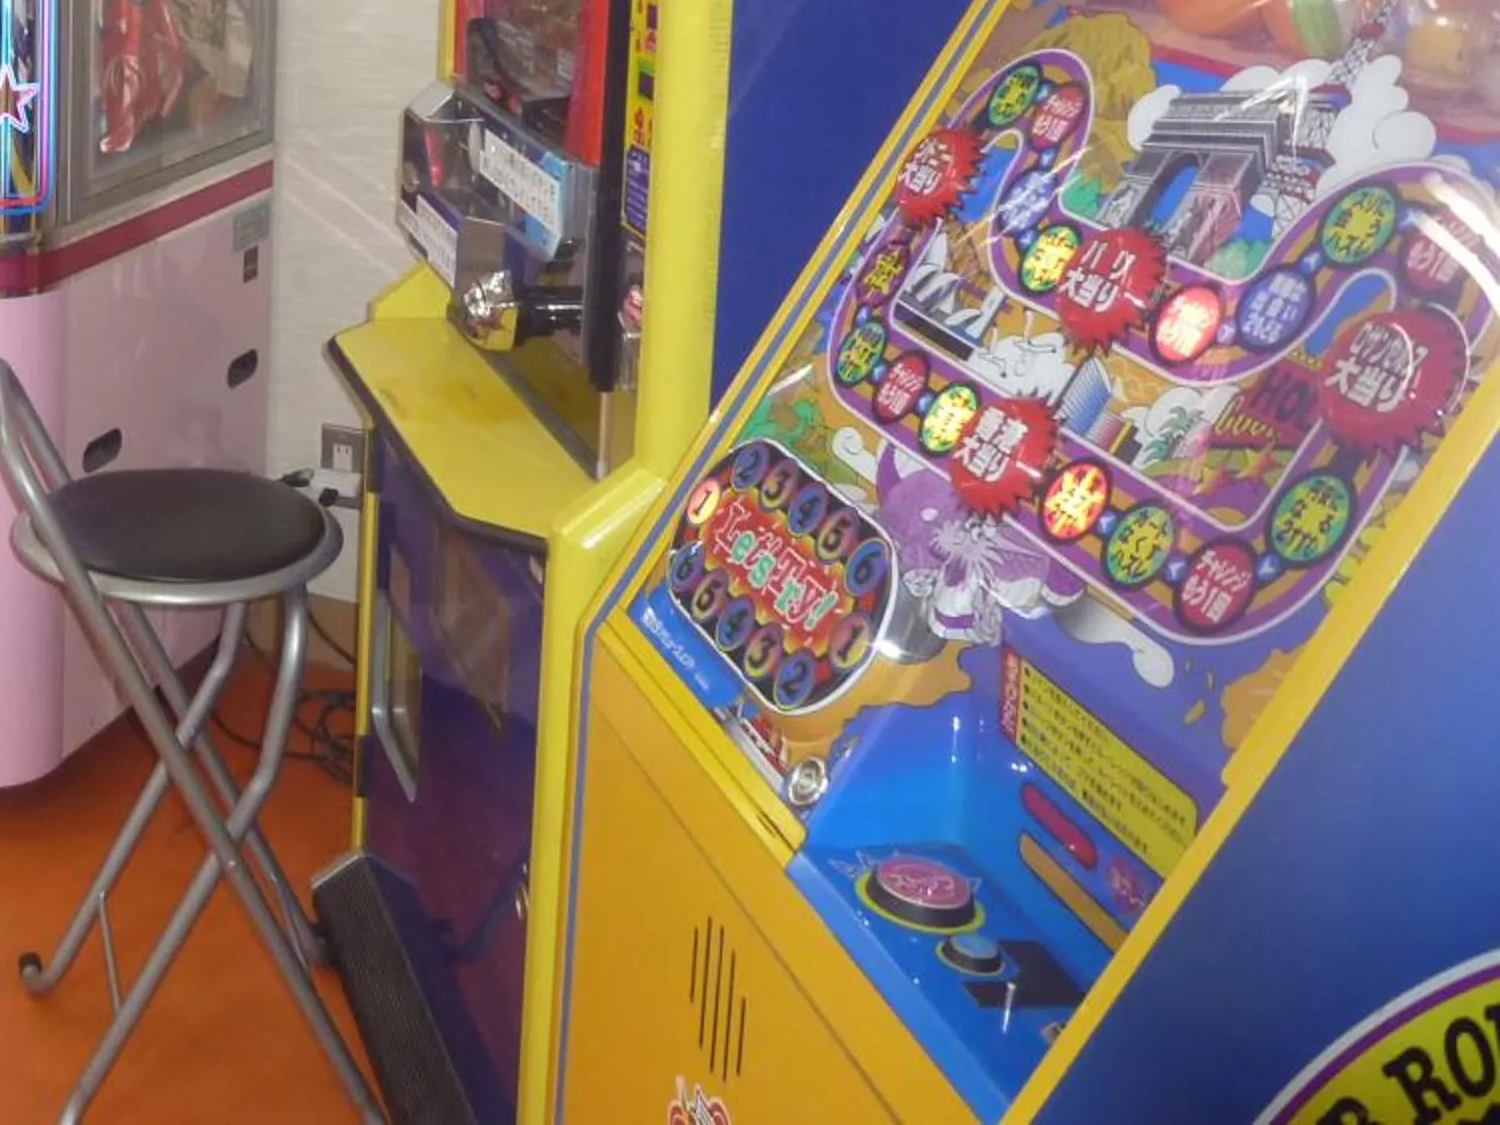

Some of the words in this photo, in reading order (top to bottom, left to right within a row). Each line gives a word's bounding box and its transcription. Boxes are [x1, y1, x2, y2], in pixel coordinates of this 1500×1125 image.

[1057, 268, 1119, 313] 大当り
[1324, 358, 1399, 413] 大当り
[952, 434, 1011, 483] 大当り
[1382, 1004, 1500, 1125] RO
